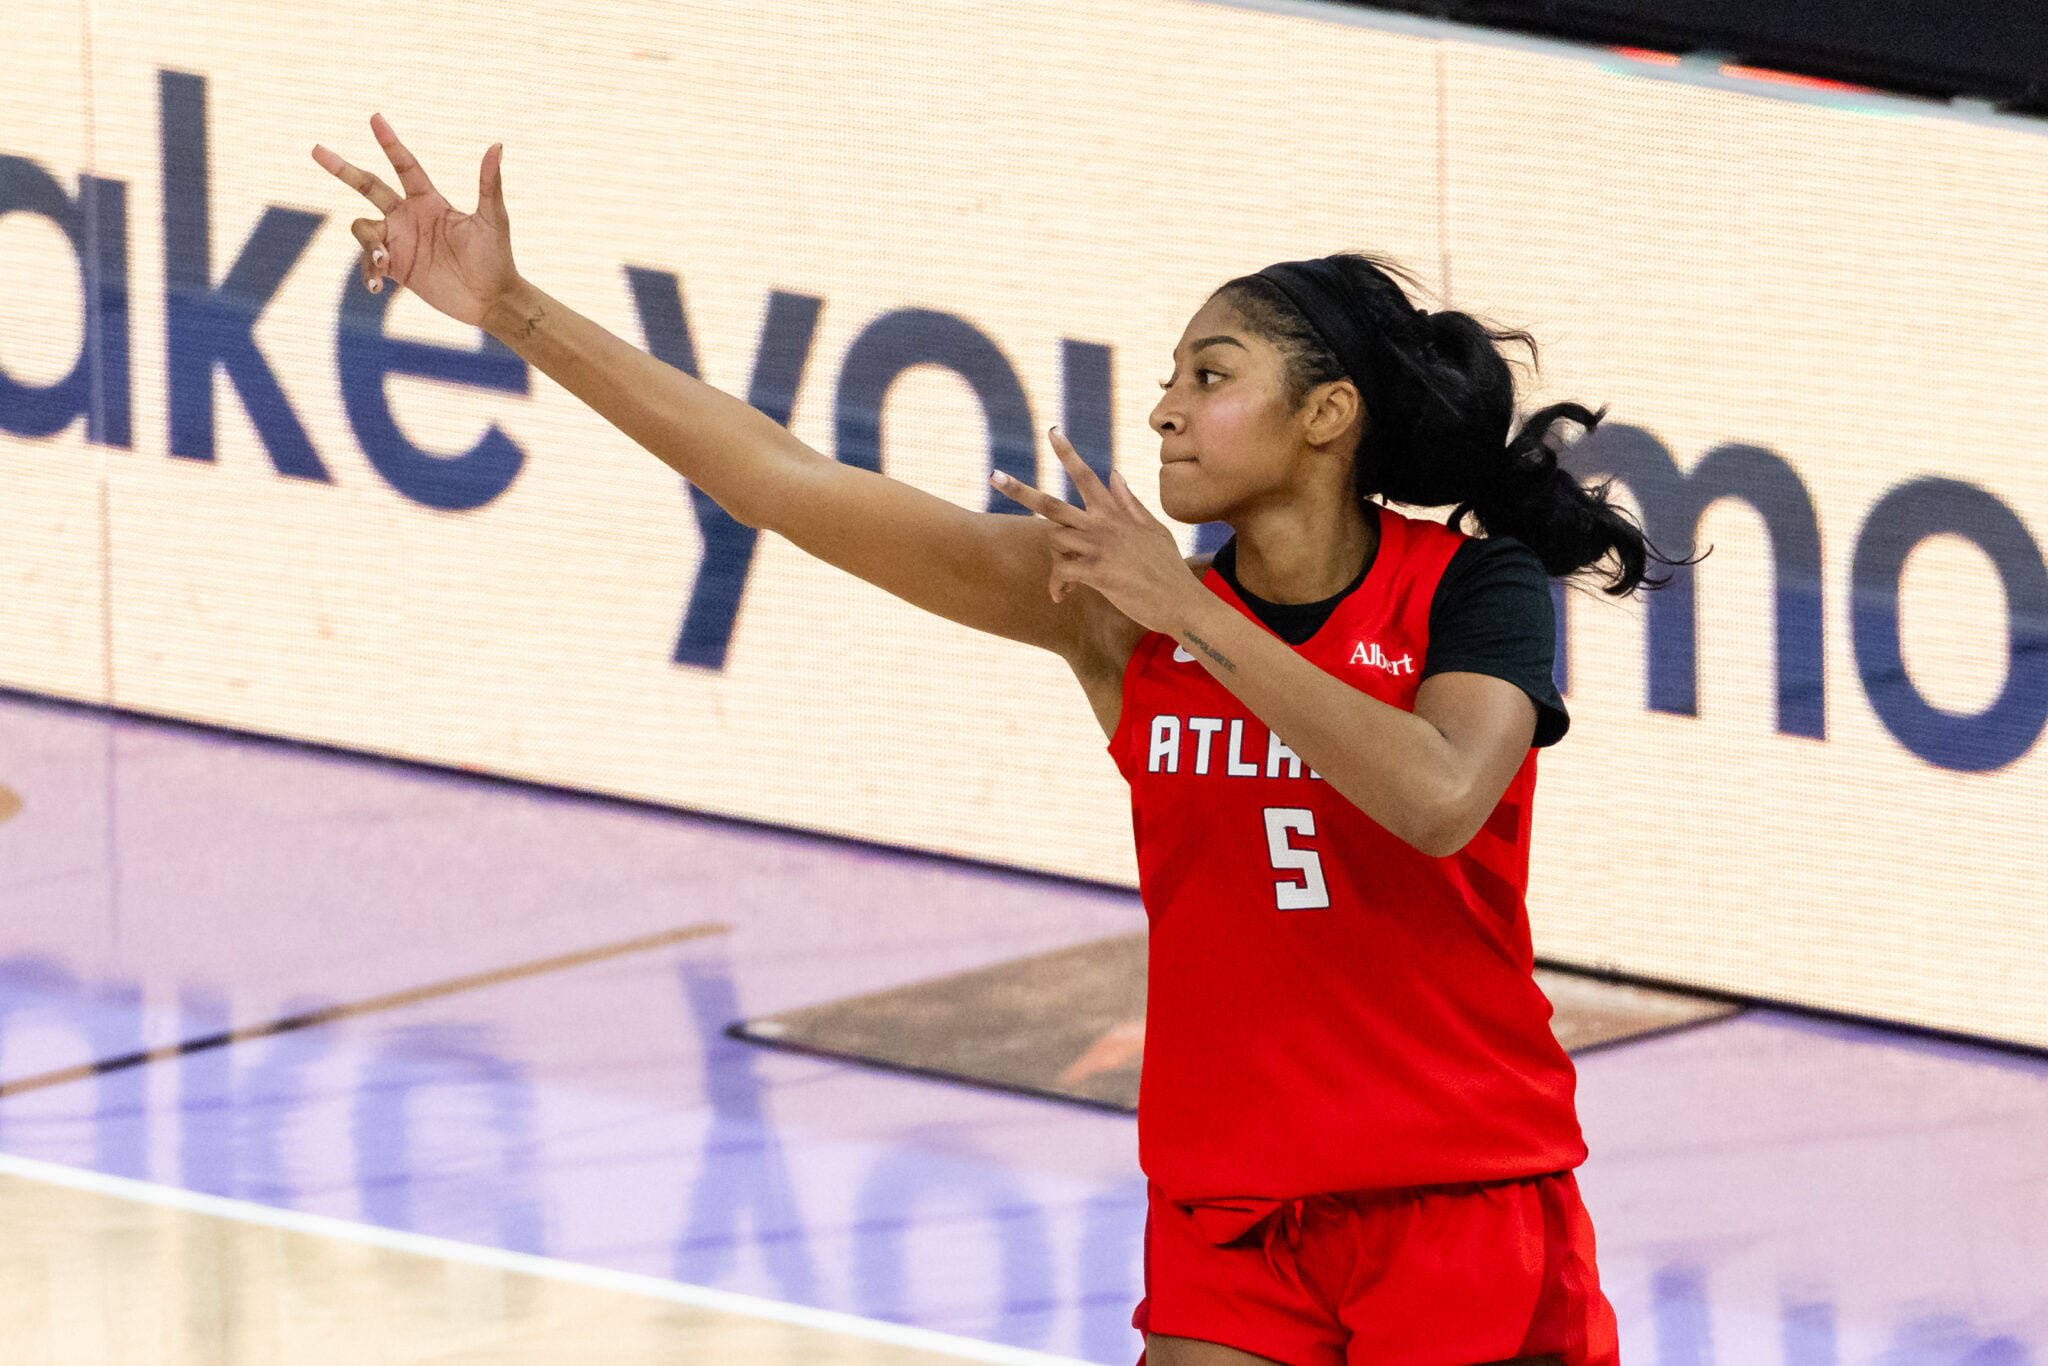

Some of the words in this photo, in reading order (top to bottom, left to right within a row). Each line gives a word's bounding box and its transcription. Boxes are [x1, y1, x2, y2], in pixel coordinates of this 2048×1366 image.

[1348, 640, 1415, 676] Albert
[1147, 714, 1325, 779] ATLA
[1263, 806, 1331, 911] 5
